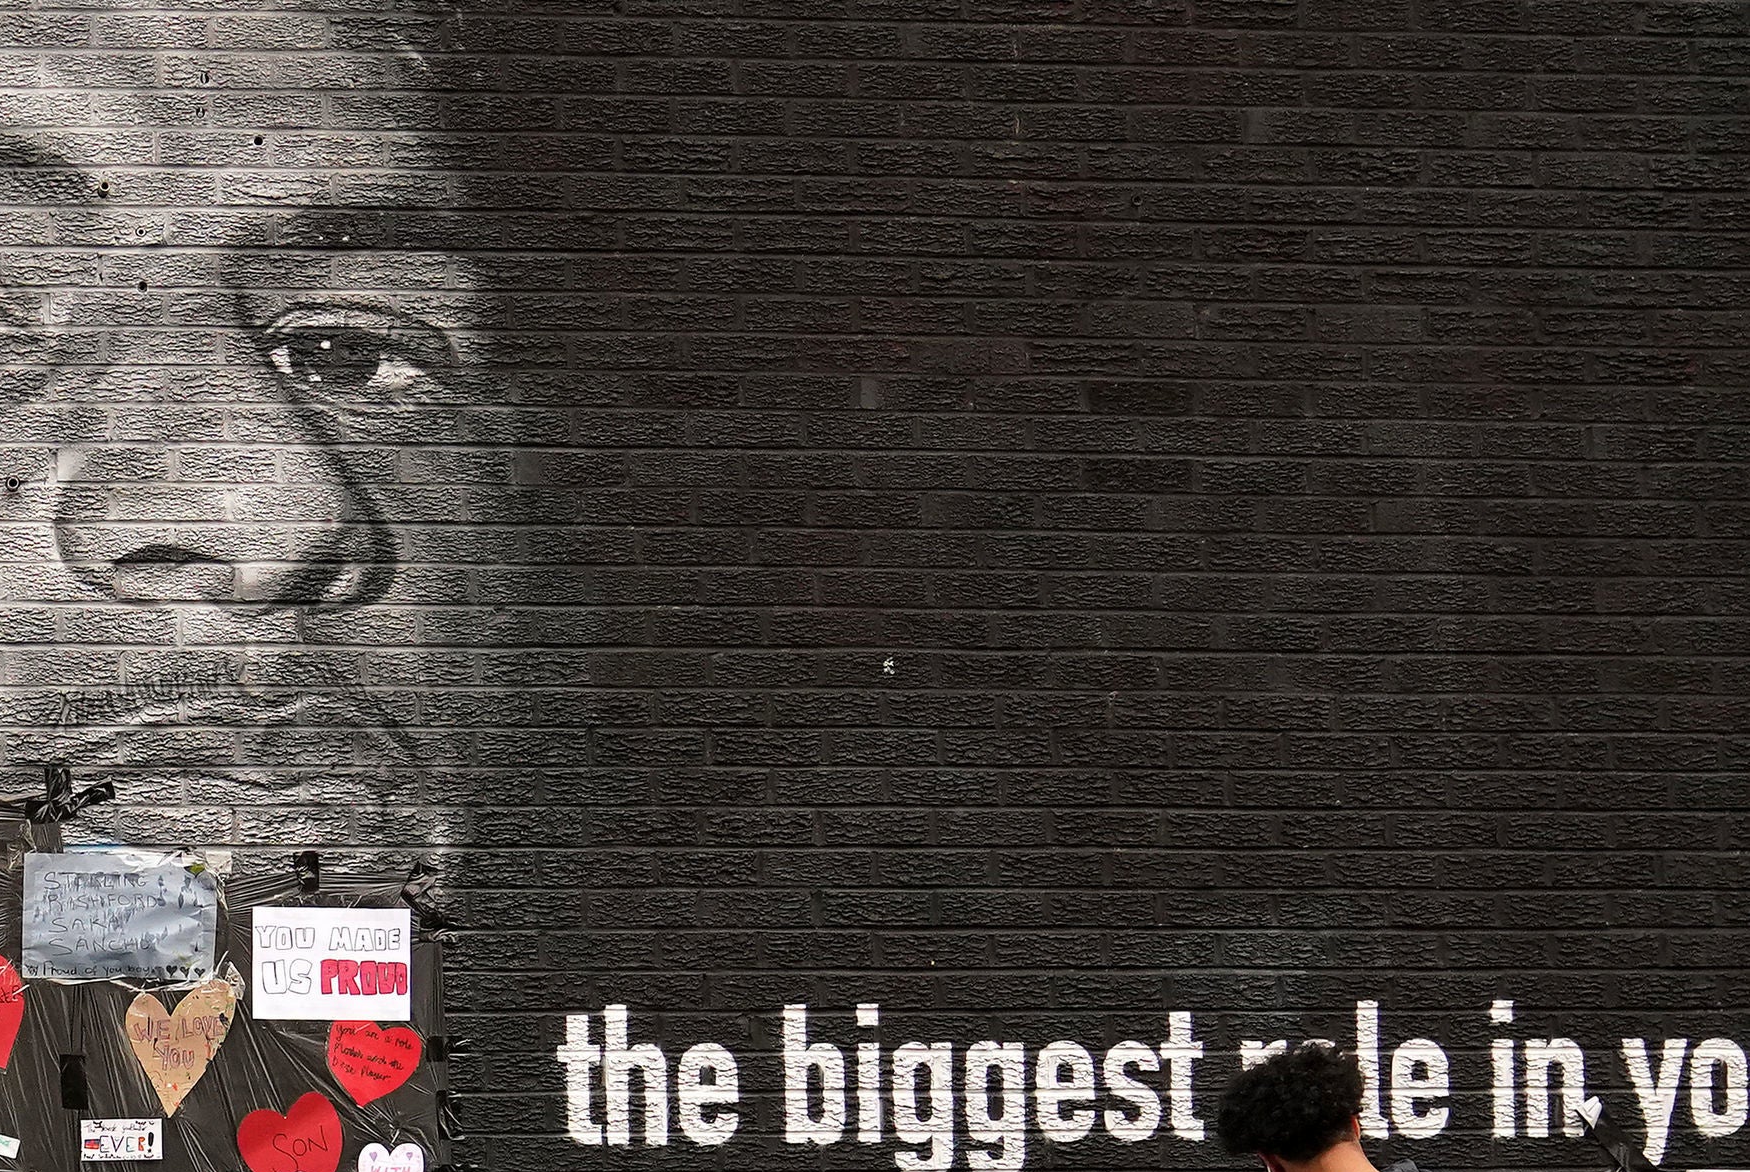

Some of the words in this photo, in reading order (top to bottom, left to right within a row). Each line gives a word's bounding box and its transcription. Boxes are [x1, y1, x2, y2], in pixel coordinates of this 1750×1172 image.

[255, 925, 316, 951] YOU
[329, 925, 402, 952] MADE
[262, 959, 313, 995] US
[320, 958, 409, 996] PROUD
[133, 1017, 171, 1042] WE
[181, 1015, 225, 1040] LOVE
[153, 1044, 195, 1071] YOU
[557, 1003, 740, 1147] the
[1240, 1000, 1450, 1140] le
[1488, 999, 1585, 1138] in
[100, 1131, 154, 1153] EVER!
